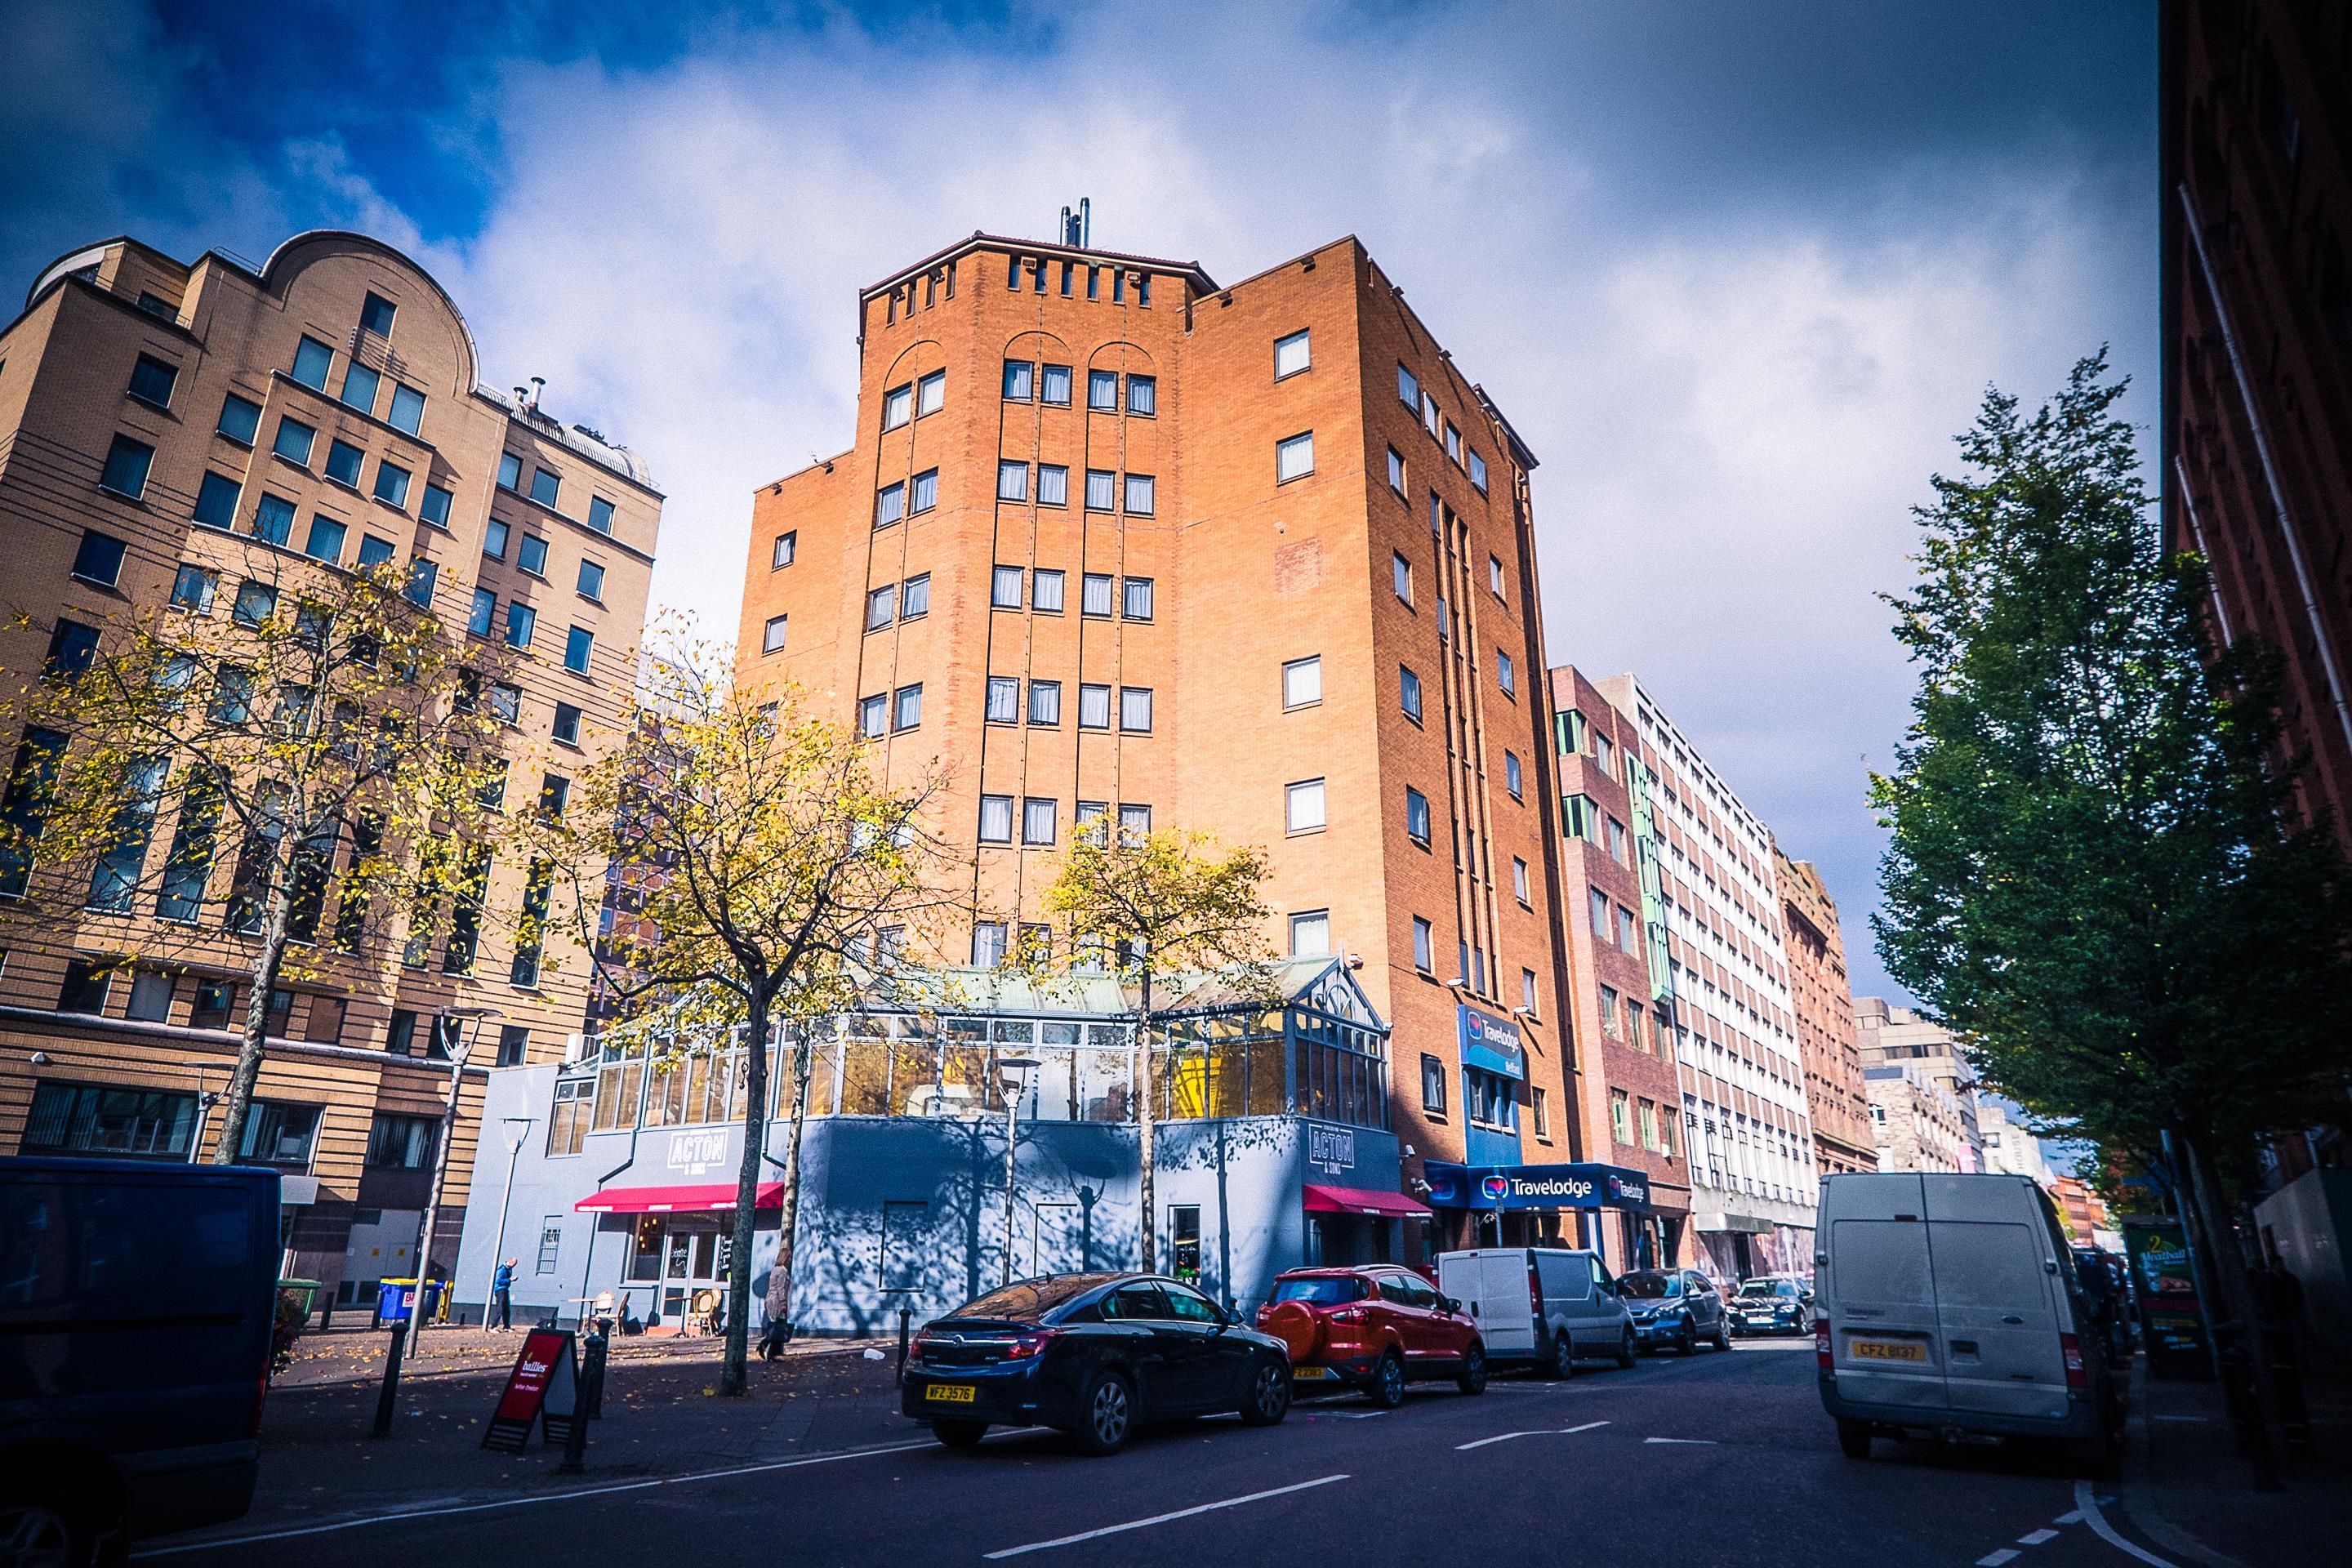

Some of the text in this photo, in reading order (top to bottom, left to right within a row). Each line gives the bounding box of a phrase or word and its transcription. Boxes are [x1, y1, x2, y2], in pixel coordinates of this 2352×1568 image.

[1481, 1018, 1520, 1053] Travelodge
[670, 1134, 725, 1164] ACTON
[1312, 1130, 1352, 1162] ACTON
[1329, 1161, 1341, 1175] SONS
[1510, 1177, 1592, 1199] Travelodge
[1618, 1179, 1645, 1204] Travelodge
[2149, 1235, 2161, 1254] 2
[1860, 1343, 1884, 1356] CFZ
[929, 1386, 970, 1400] WFZ 3576
